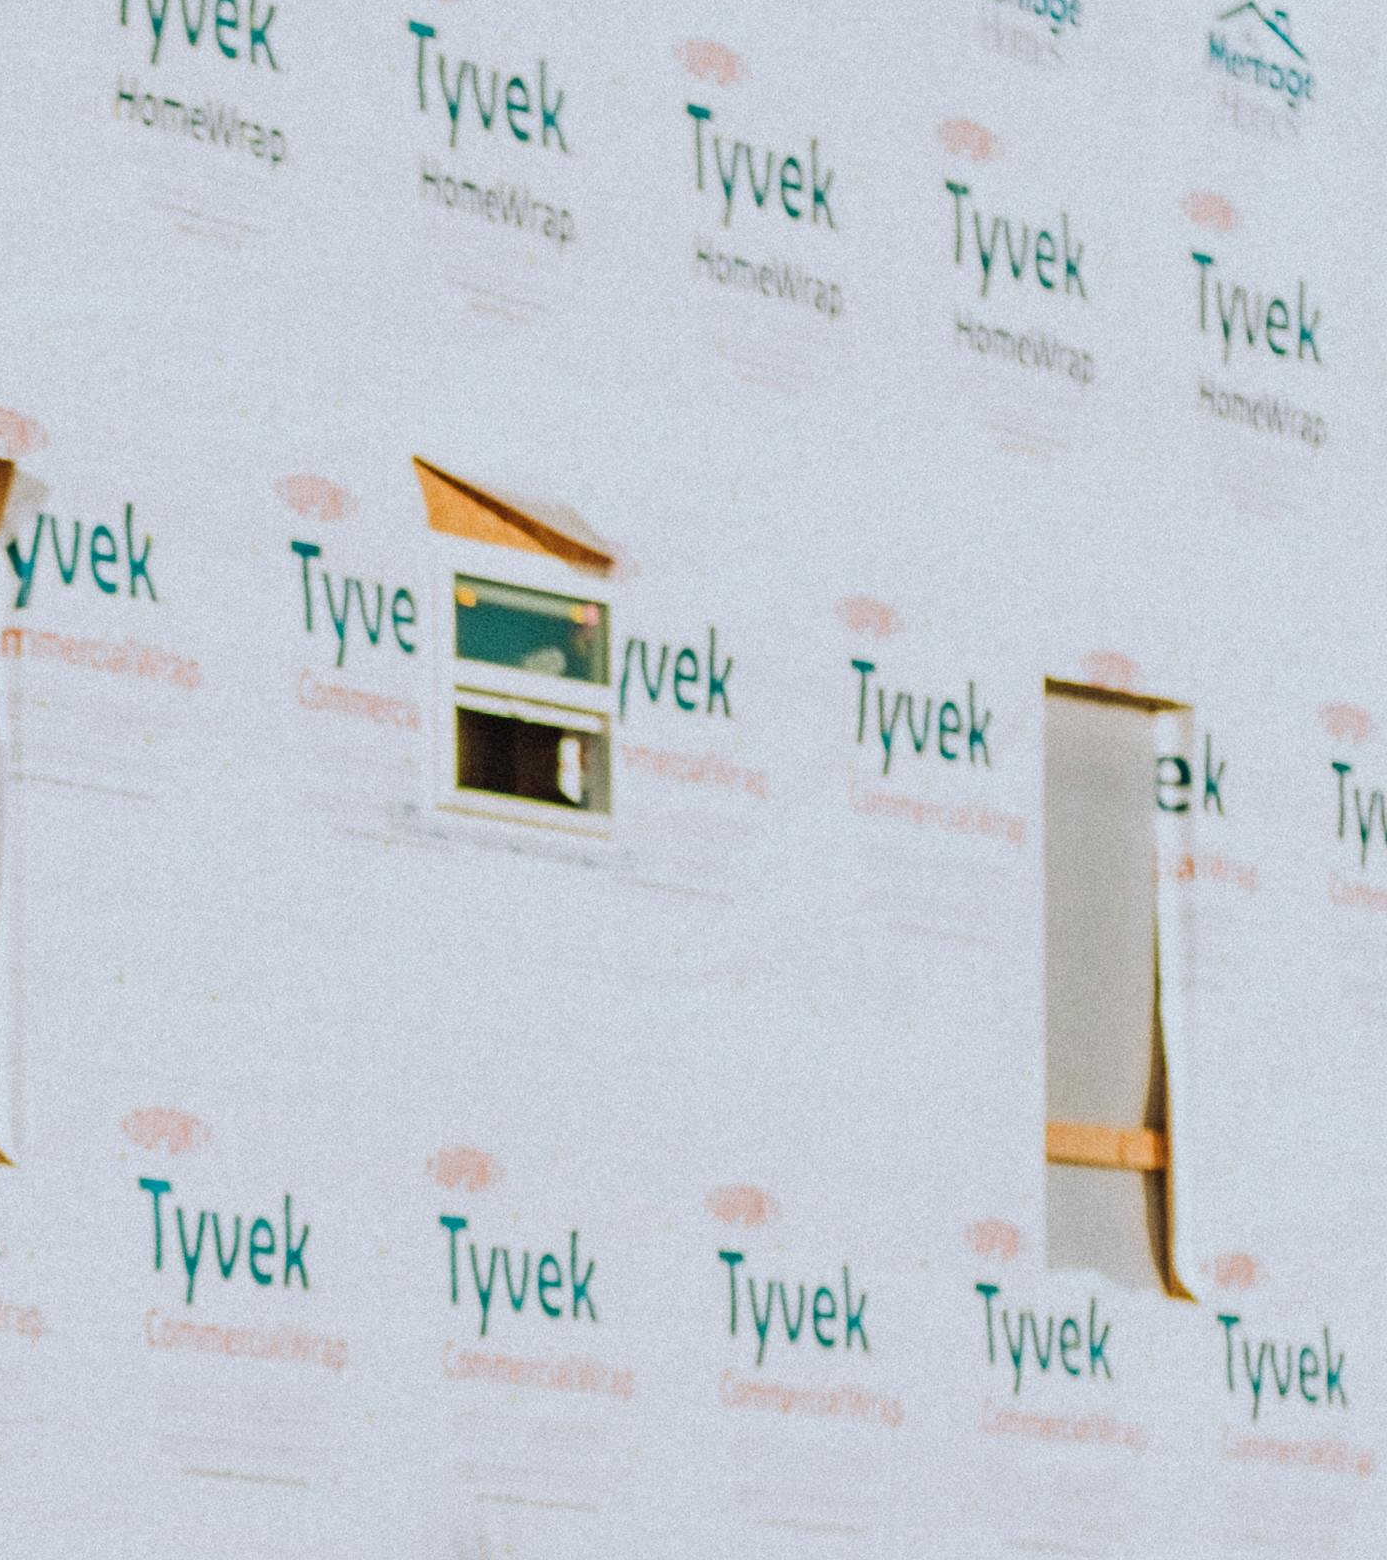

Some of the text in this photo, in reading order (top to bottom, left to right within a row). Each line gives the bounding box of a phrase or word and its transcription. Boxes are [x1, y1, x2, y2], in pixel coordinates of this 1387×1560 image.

[115, 73, 286, 164] HomeWrap
[409, 20, 571, 154] Tyvek
[686, 103, 837, 229] Tyvek
[945, 180, 1088, 301] Tyvek
[1192, 252, 1322, 364] Tyvek
[851, 659, 991, 777] Tyvek
[138, 1177, 308, 1304] Tyvek
[439, 1216, 598, 1336] Tyvek
[719, 1250, 870, 1365] Tyvek
[975, 1283, 1112, 1394] Tyvek
[1217, 1314, 1346, 1420] Tyvek
